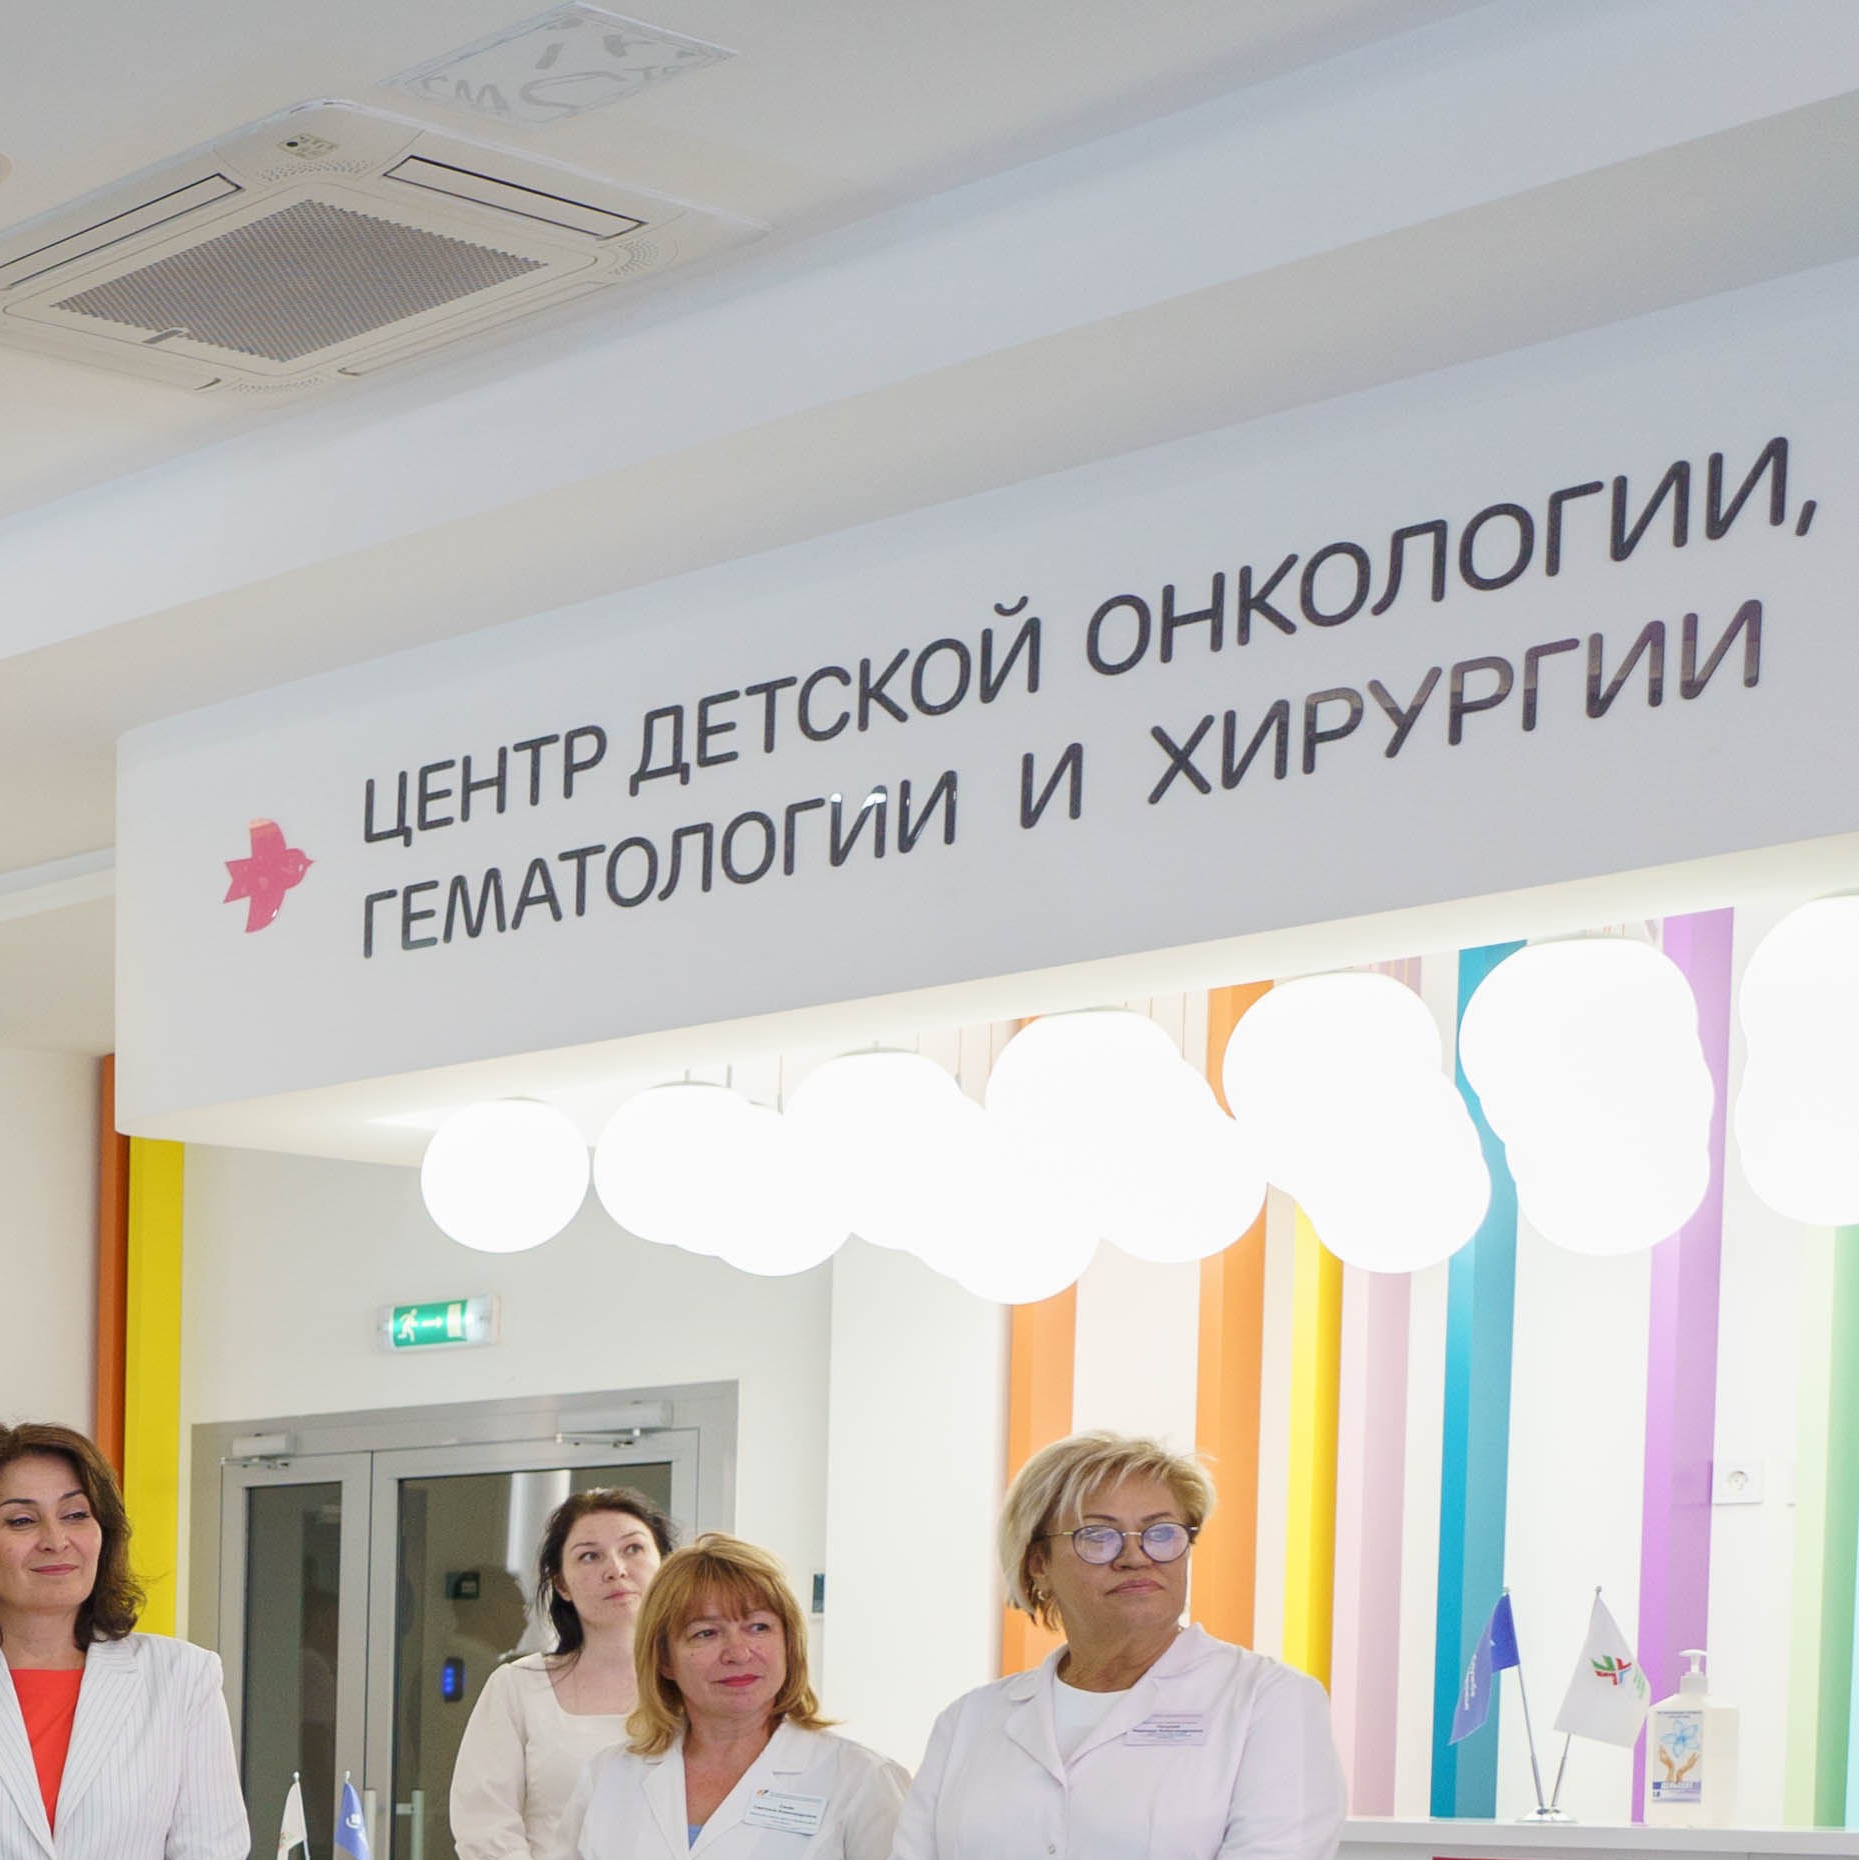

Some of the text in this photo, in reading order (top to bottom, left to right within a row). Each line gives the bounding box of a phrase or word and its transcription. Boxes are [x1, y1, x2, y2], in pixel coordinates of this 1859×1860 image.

[363, 436, 1818, 849] ЦЕНТР ДЕТСКОЙ ОНКОЛОГИИ,
[363, 598, 1764, 960] ГЕМАТОЛОГИИ И ХИРУРГИИ
